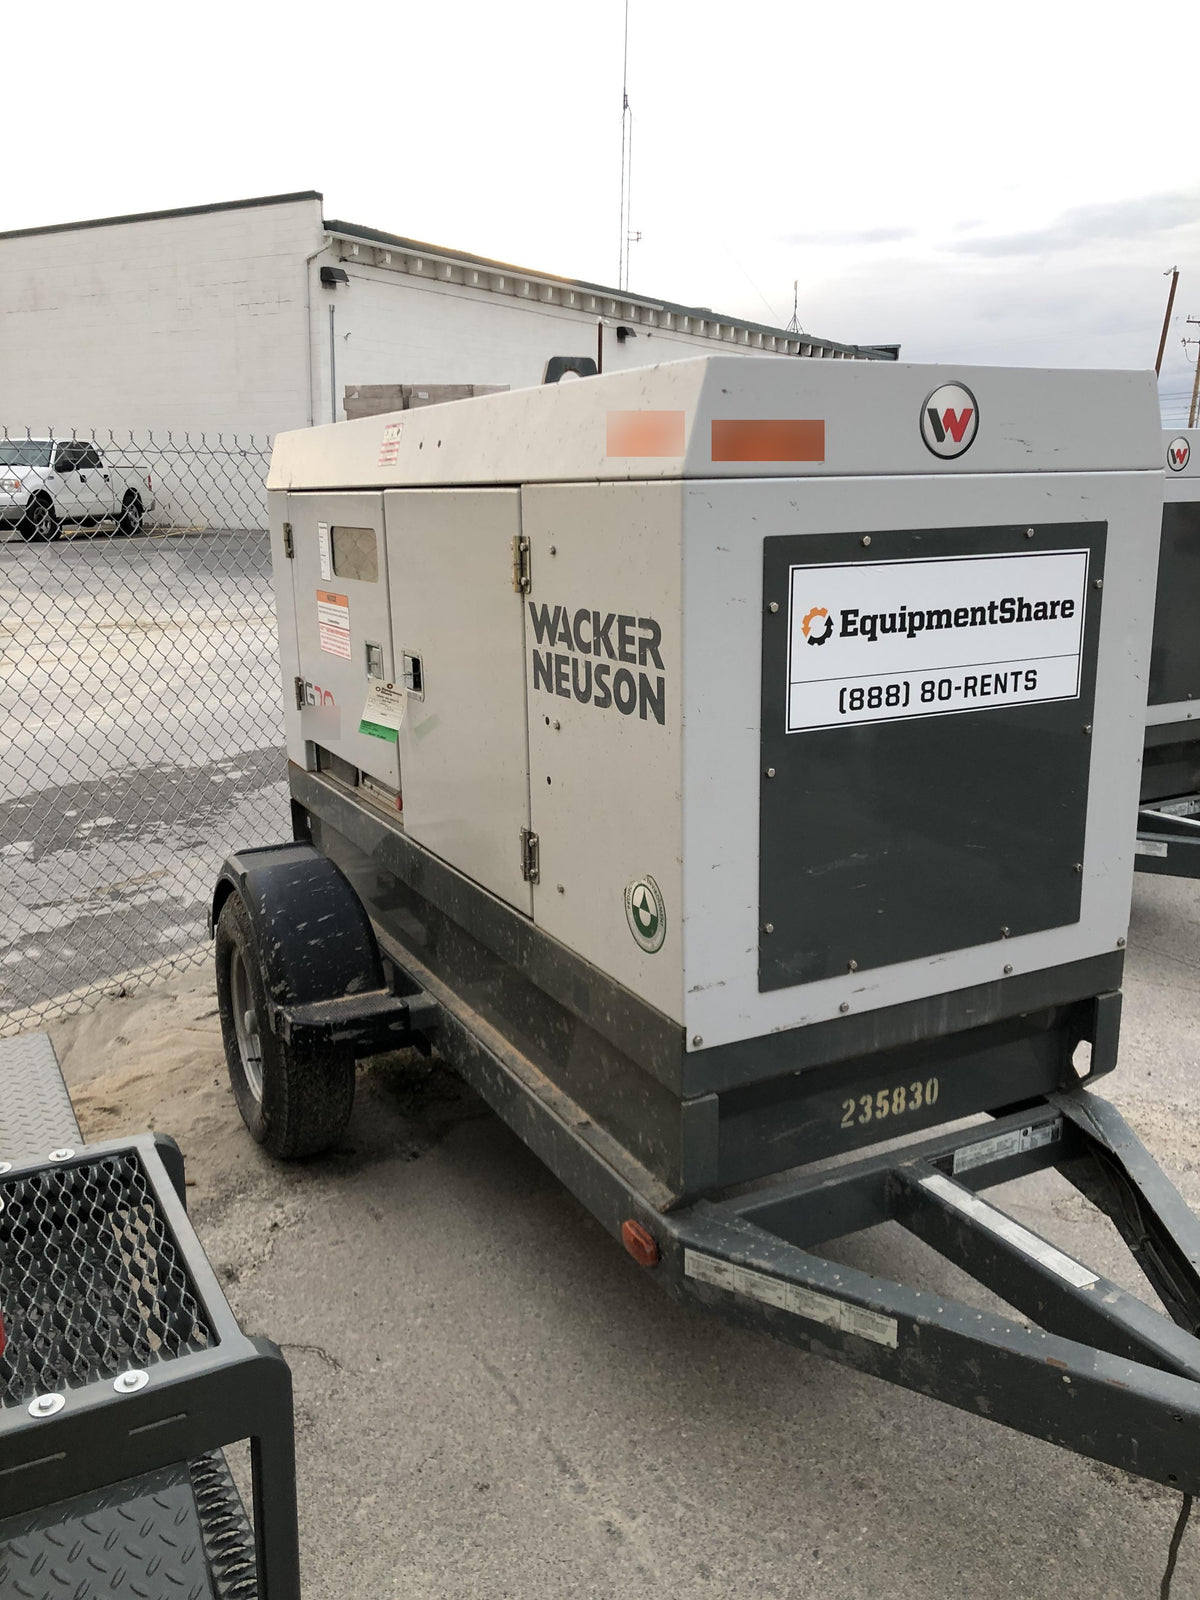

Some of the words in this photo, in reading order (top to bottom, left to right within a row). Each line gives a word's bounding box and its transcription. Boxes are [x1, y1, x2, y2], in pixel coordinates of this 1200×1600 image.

[528, 601, 666, 671] WACKER
[839, 596, 1075, 642] EquipmentShare
[532, 648, 666, 726] NEUSON
[838, 681, 910, 714] (888)
[920, 669, 1038, 704] 80-RENTS
[840, 1076, 940, 1129] 235830
